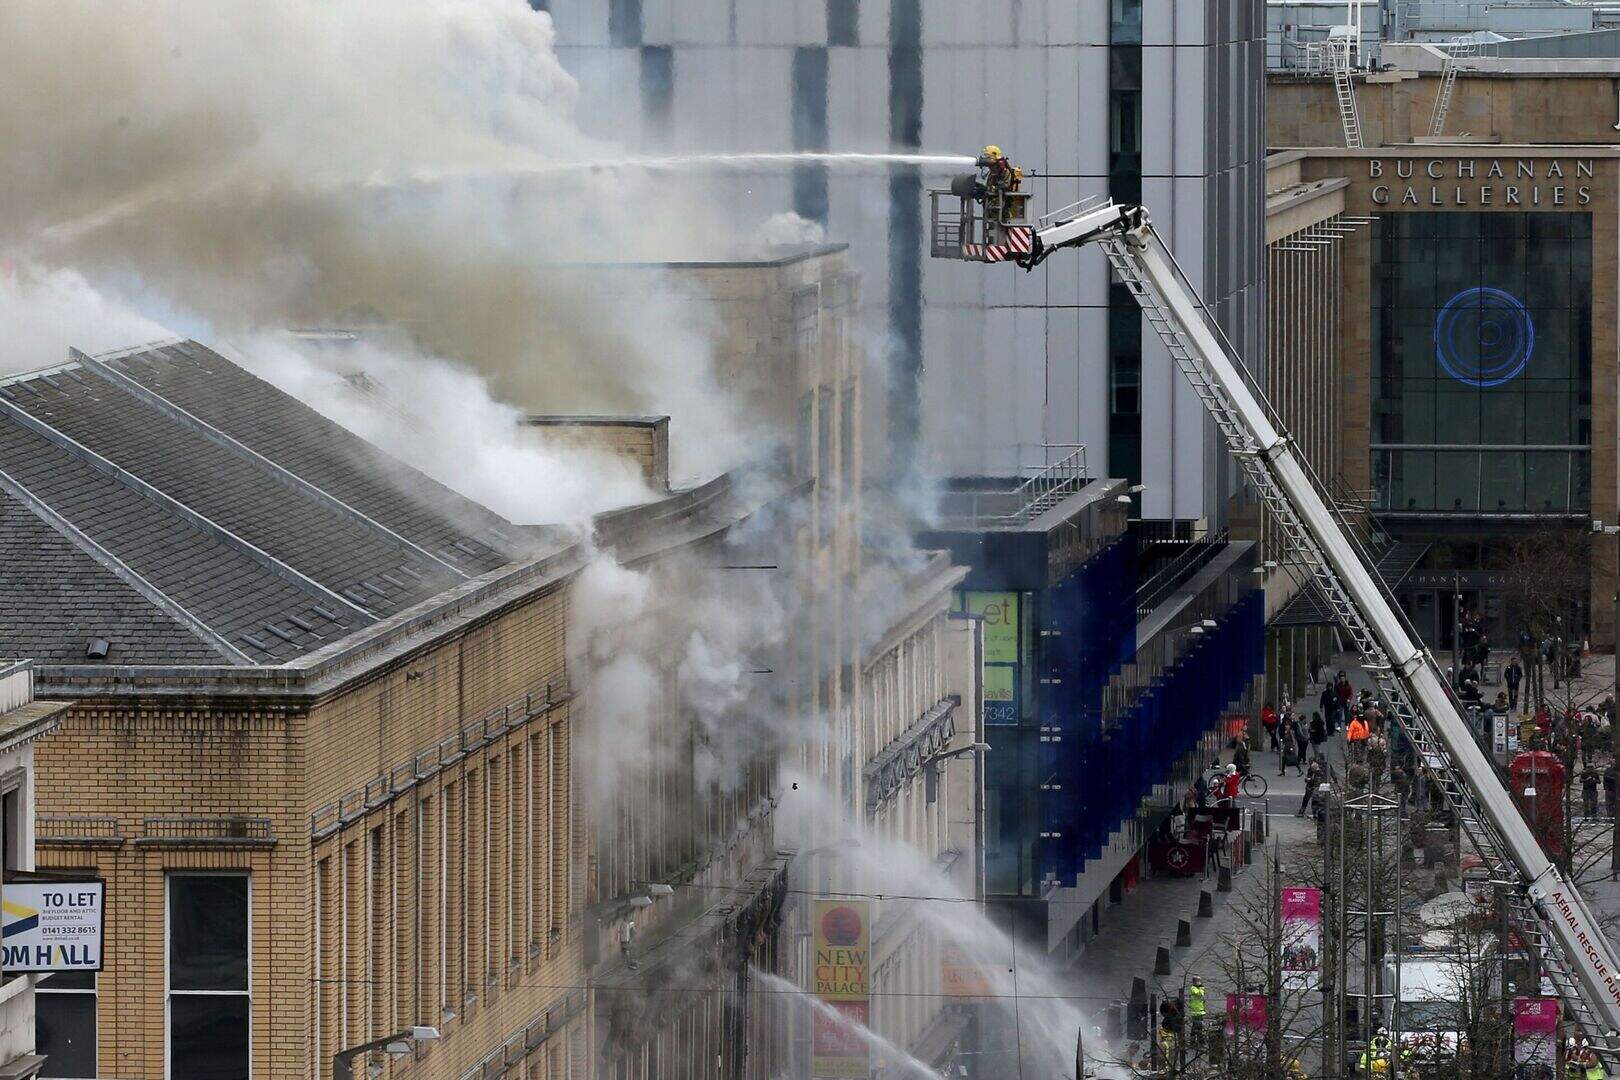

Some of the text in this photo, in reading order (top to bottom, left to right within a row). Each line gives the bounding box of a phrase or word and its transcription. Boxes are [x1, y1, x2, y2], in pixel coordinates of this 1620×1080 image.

[1370, 160, 1594, 178] BUCHANAN
[1372, 186, 1591, 205] GALLERIES
[43, 893, 96, 906] TO LET
[62, 926, 76, 934] 332
[78, 926, 96, 934] 8615
[1552, 891, 1579, 934] AERIAL
[1576, 932, 1609, 978] RESCUE
[36, 945, 96, 966] HALL
[816, 950, 867, 965] NEW
[816, 966, 865, 981] CITY
[817, 982, 867, 993] PALACE
